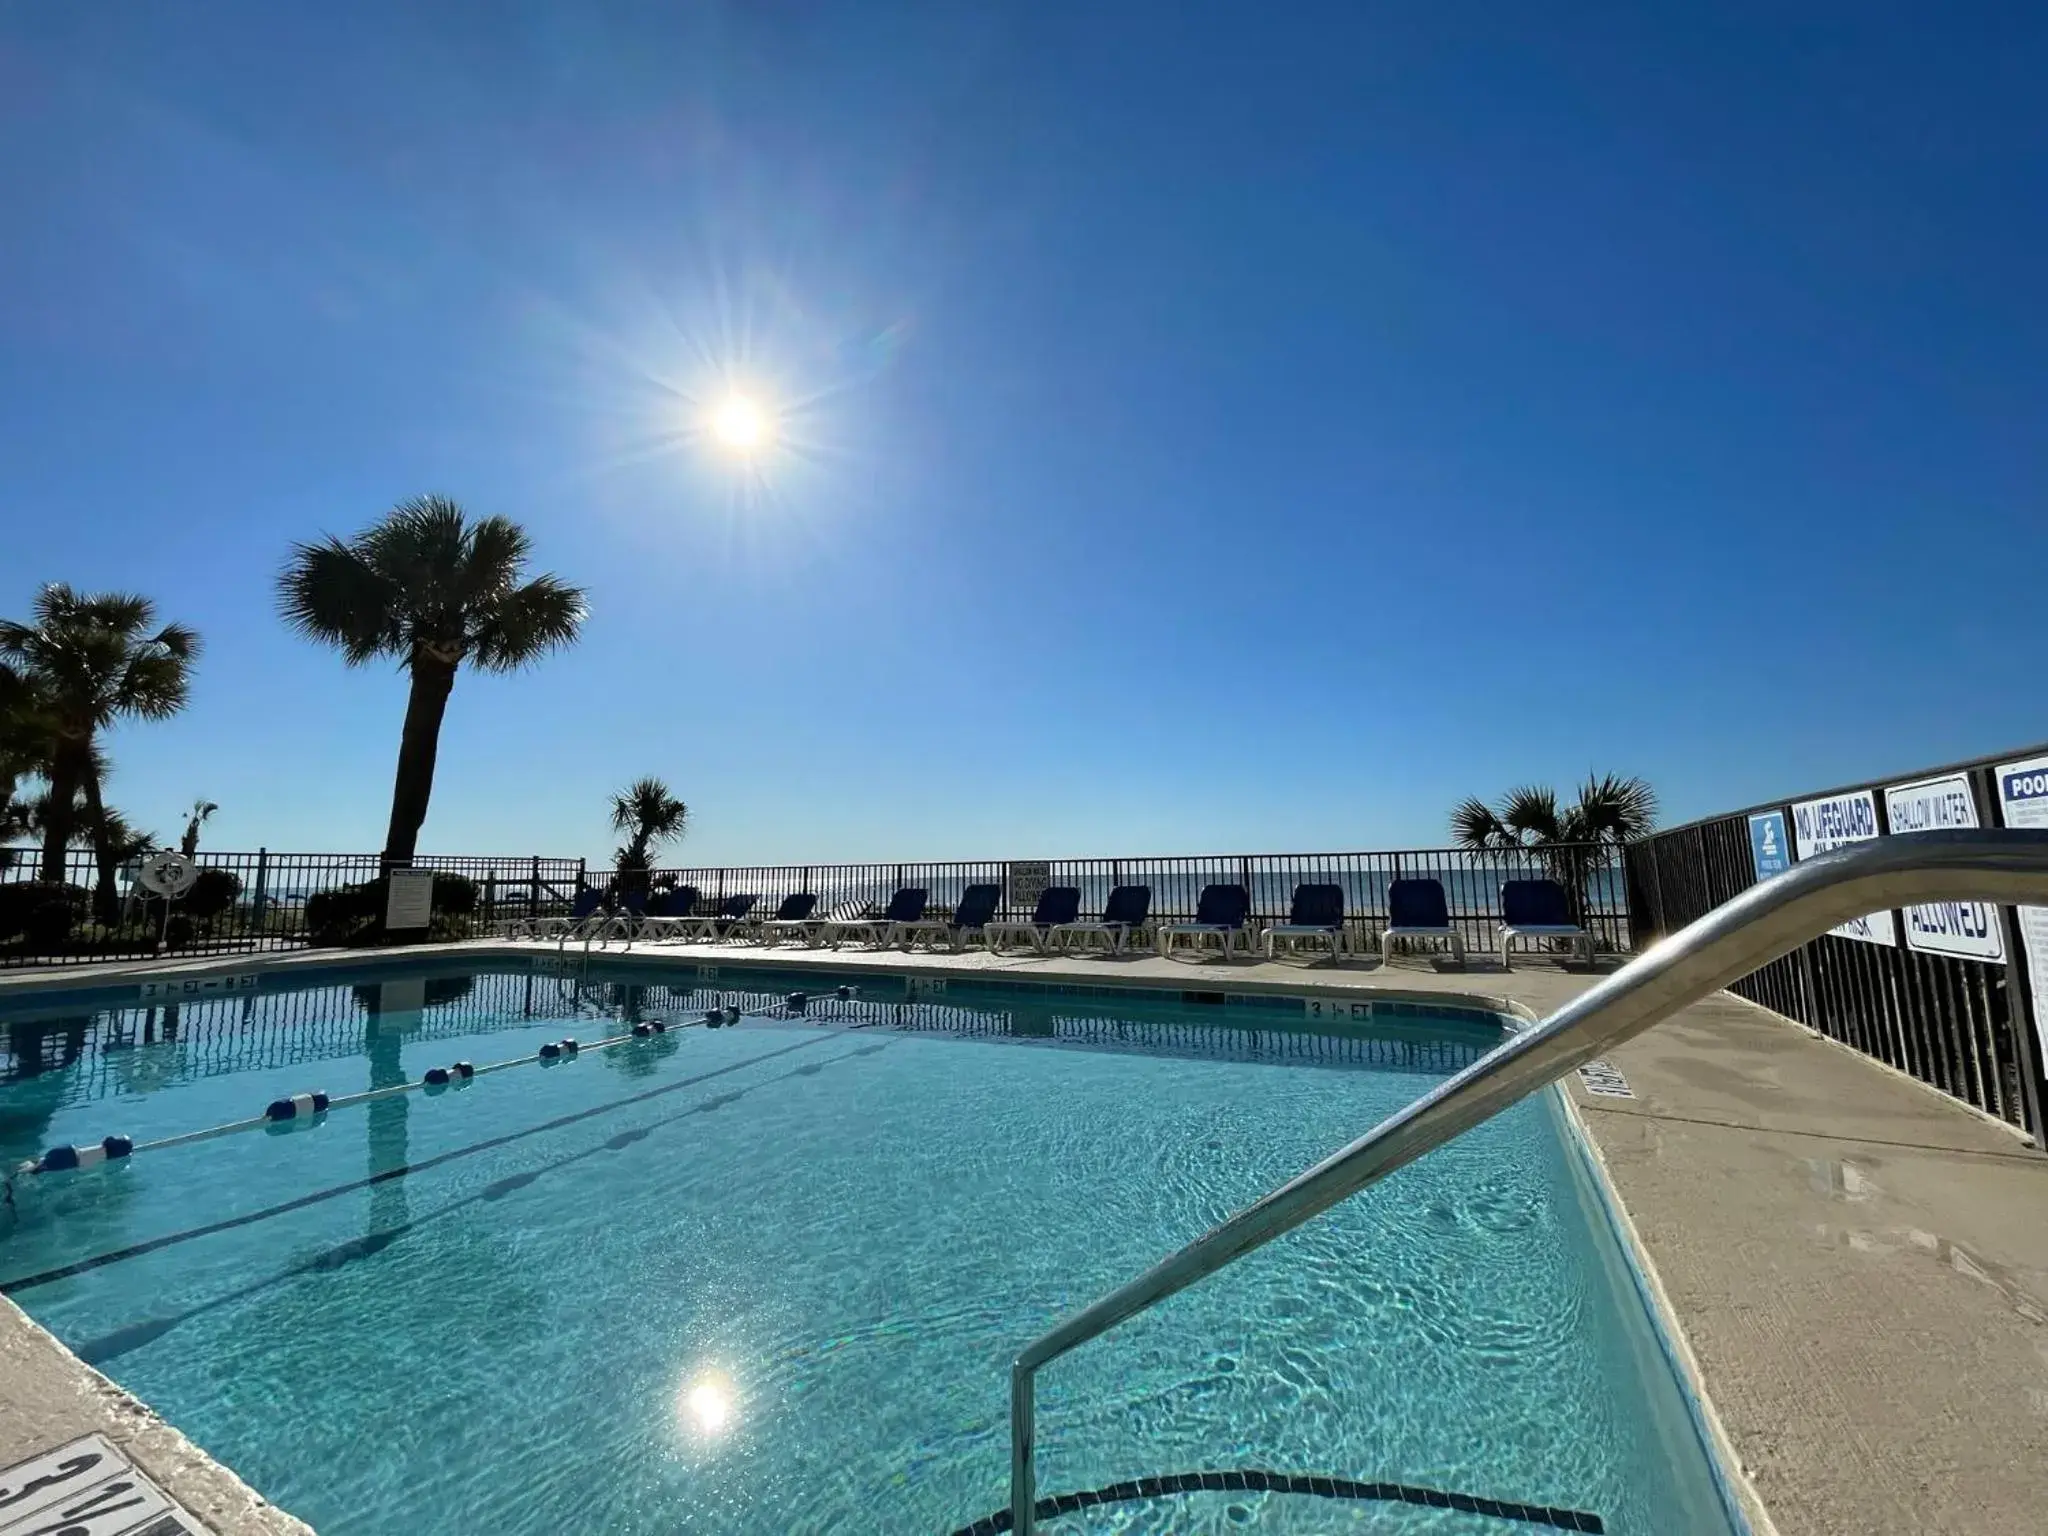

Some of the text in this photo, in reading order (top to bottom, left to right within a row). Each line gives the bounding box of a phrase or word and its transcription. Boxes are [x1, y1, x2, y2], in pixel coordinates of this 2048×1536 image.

[1796, 797, 1874, 840] NO LIFEGUARD
[1893, 793, 1970, 831] SHALLOW WATER
[1912, 902, 1987, 938] ALLOWED
